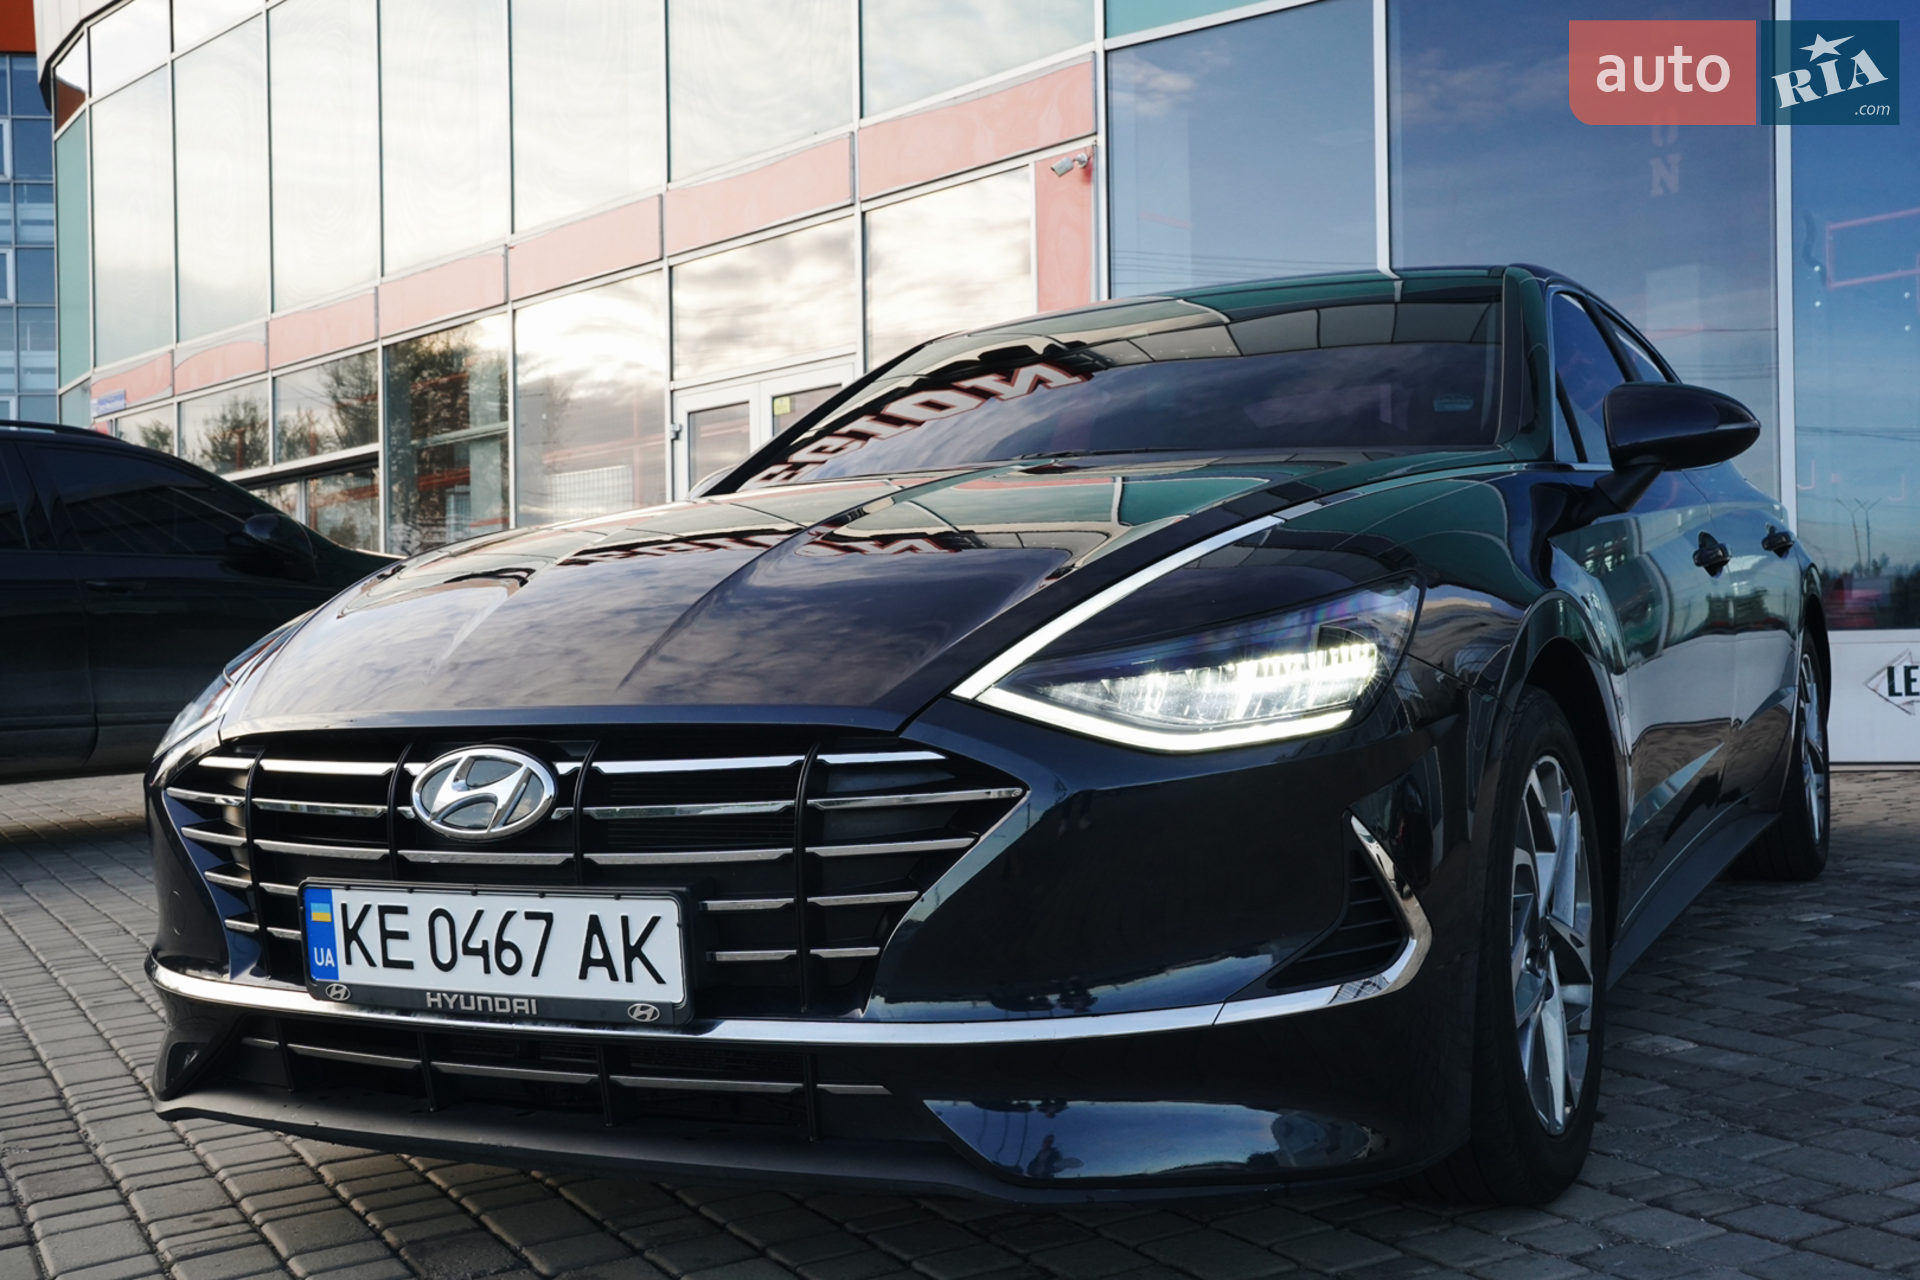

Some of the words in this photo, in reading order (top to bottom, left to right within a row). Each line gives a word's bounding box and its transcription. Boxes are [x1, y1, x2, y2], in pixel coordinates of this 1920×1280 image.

[341, 902, 414, 970] KE
[428, 907, 554, 978] 0467
[578, 913, 667, 985] AK
[314, 946, 335, 967] UA
[426, 991, 538, 1015] HYUNDAI
